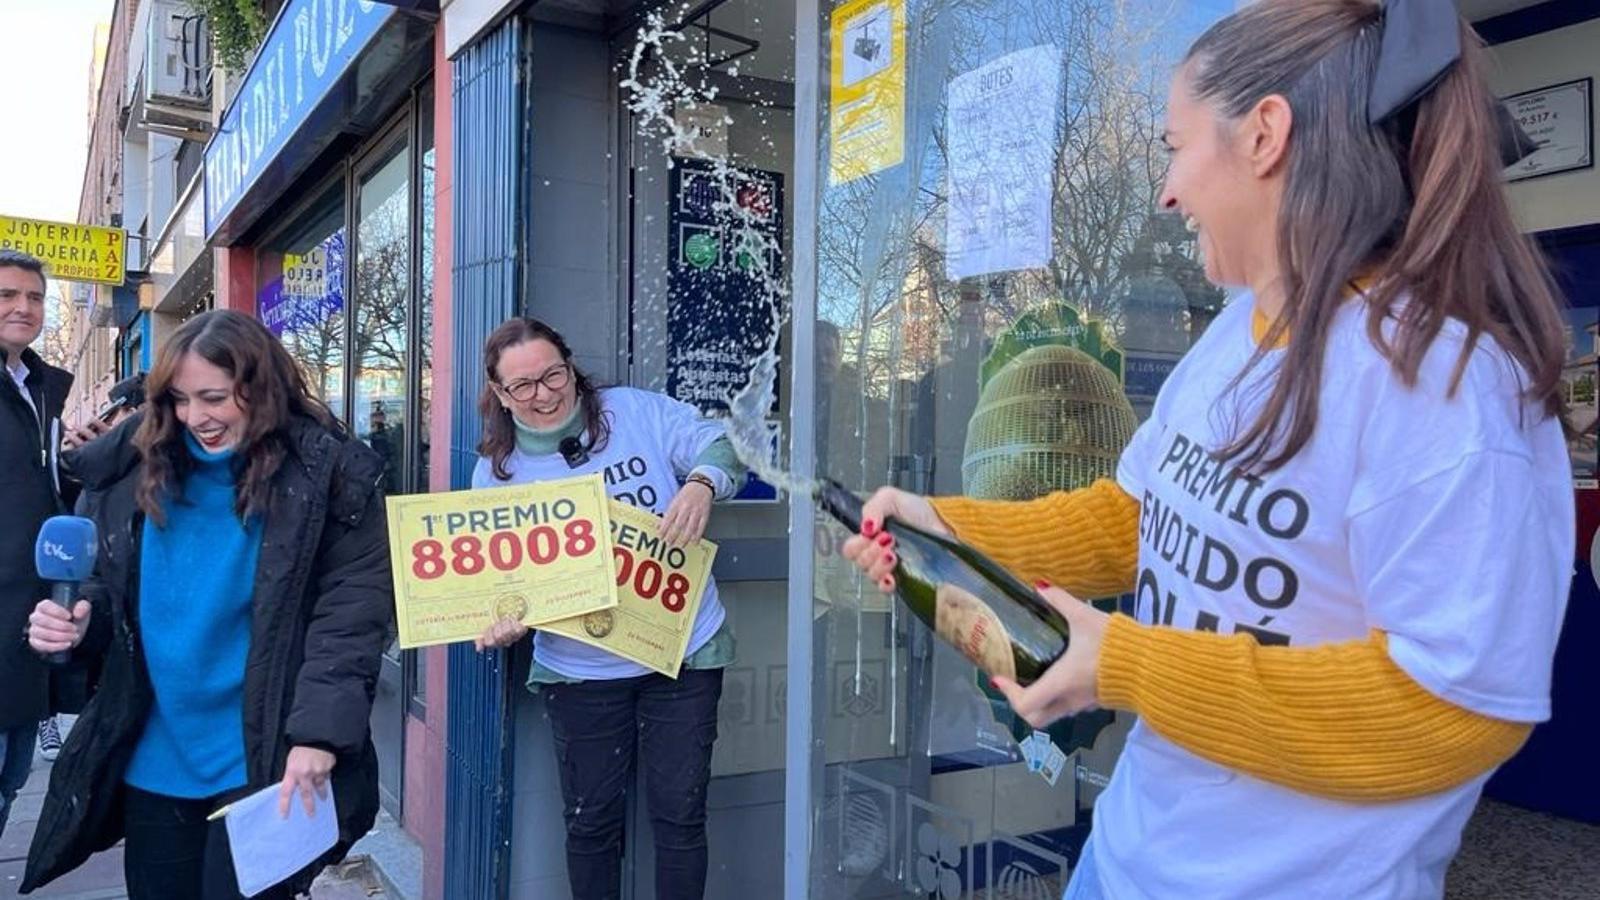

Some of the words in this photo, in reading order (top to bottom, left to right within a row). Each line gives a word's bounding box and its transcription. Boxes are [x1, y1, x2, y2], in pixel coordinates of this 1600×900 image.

[207, 102, 251, 223] TELAS
[254, 42, 290, 160] DEL
[7, 221, 92, 244] JOYERIA
[105, 232, 120, 279] PAZ
[56, 264, 101, 278] PROPIOS
[1158, 432, 1310, 540] PREMIO
[446, 499, 576, 535] PREMIO
[412, 519, 596, 580] 88008
